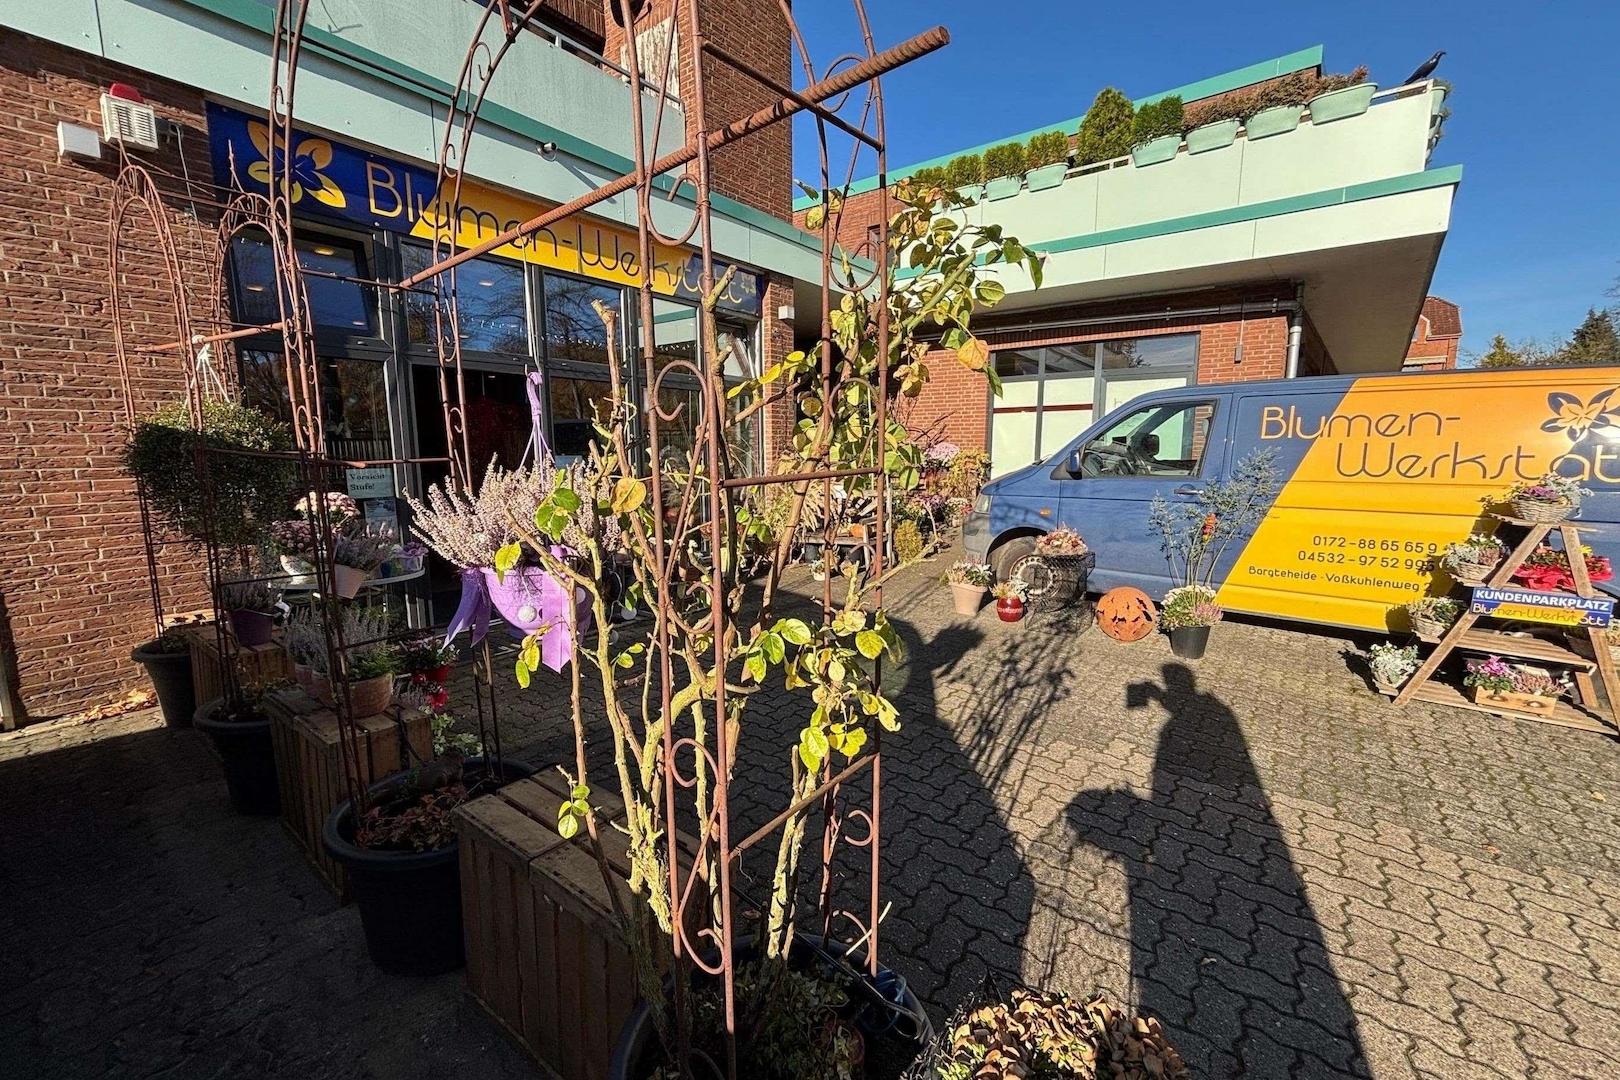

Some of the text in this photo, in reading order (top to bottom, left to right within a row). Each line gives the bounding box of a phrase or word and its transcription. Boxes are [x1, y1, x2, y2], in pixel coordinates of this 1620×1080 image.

[1260, 405, 1461, 439] Blumen-
[349, 473, 385, 481] Vorsicht
[350, 482, 375, 491] Stufe!
[1380, 540, 1399, 551] 65
[1380, 557, 1399, 569] 52
[1325, 573, 1420, 593] Voßkuhlenweg
[1475, 590, 1610, 611] KUNDENPARKPLATZ
